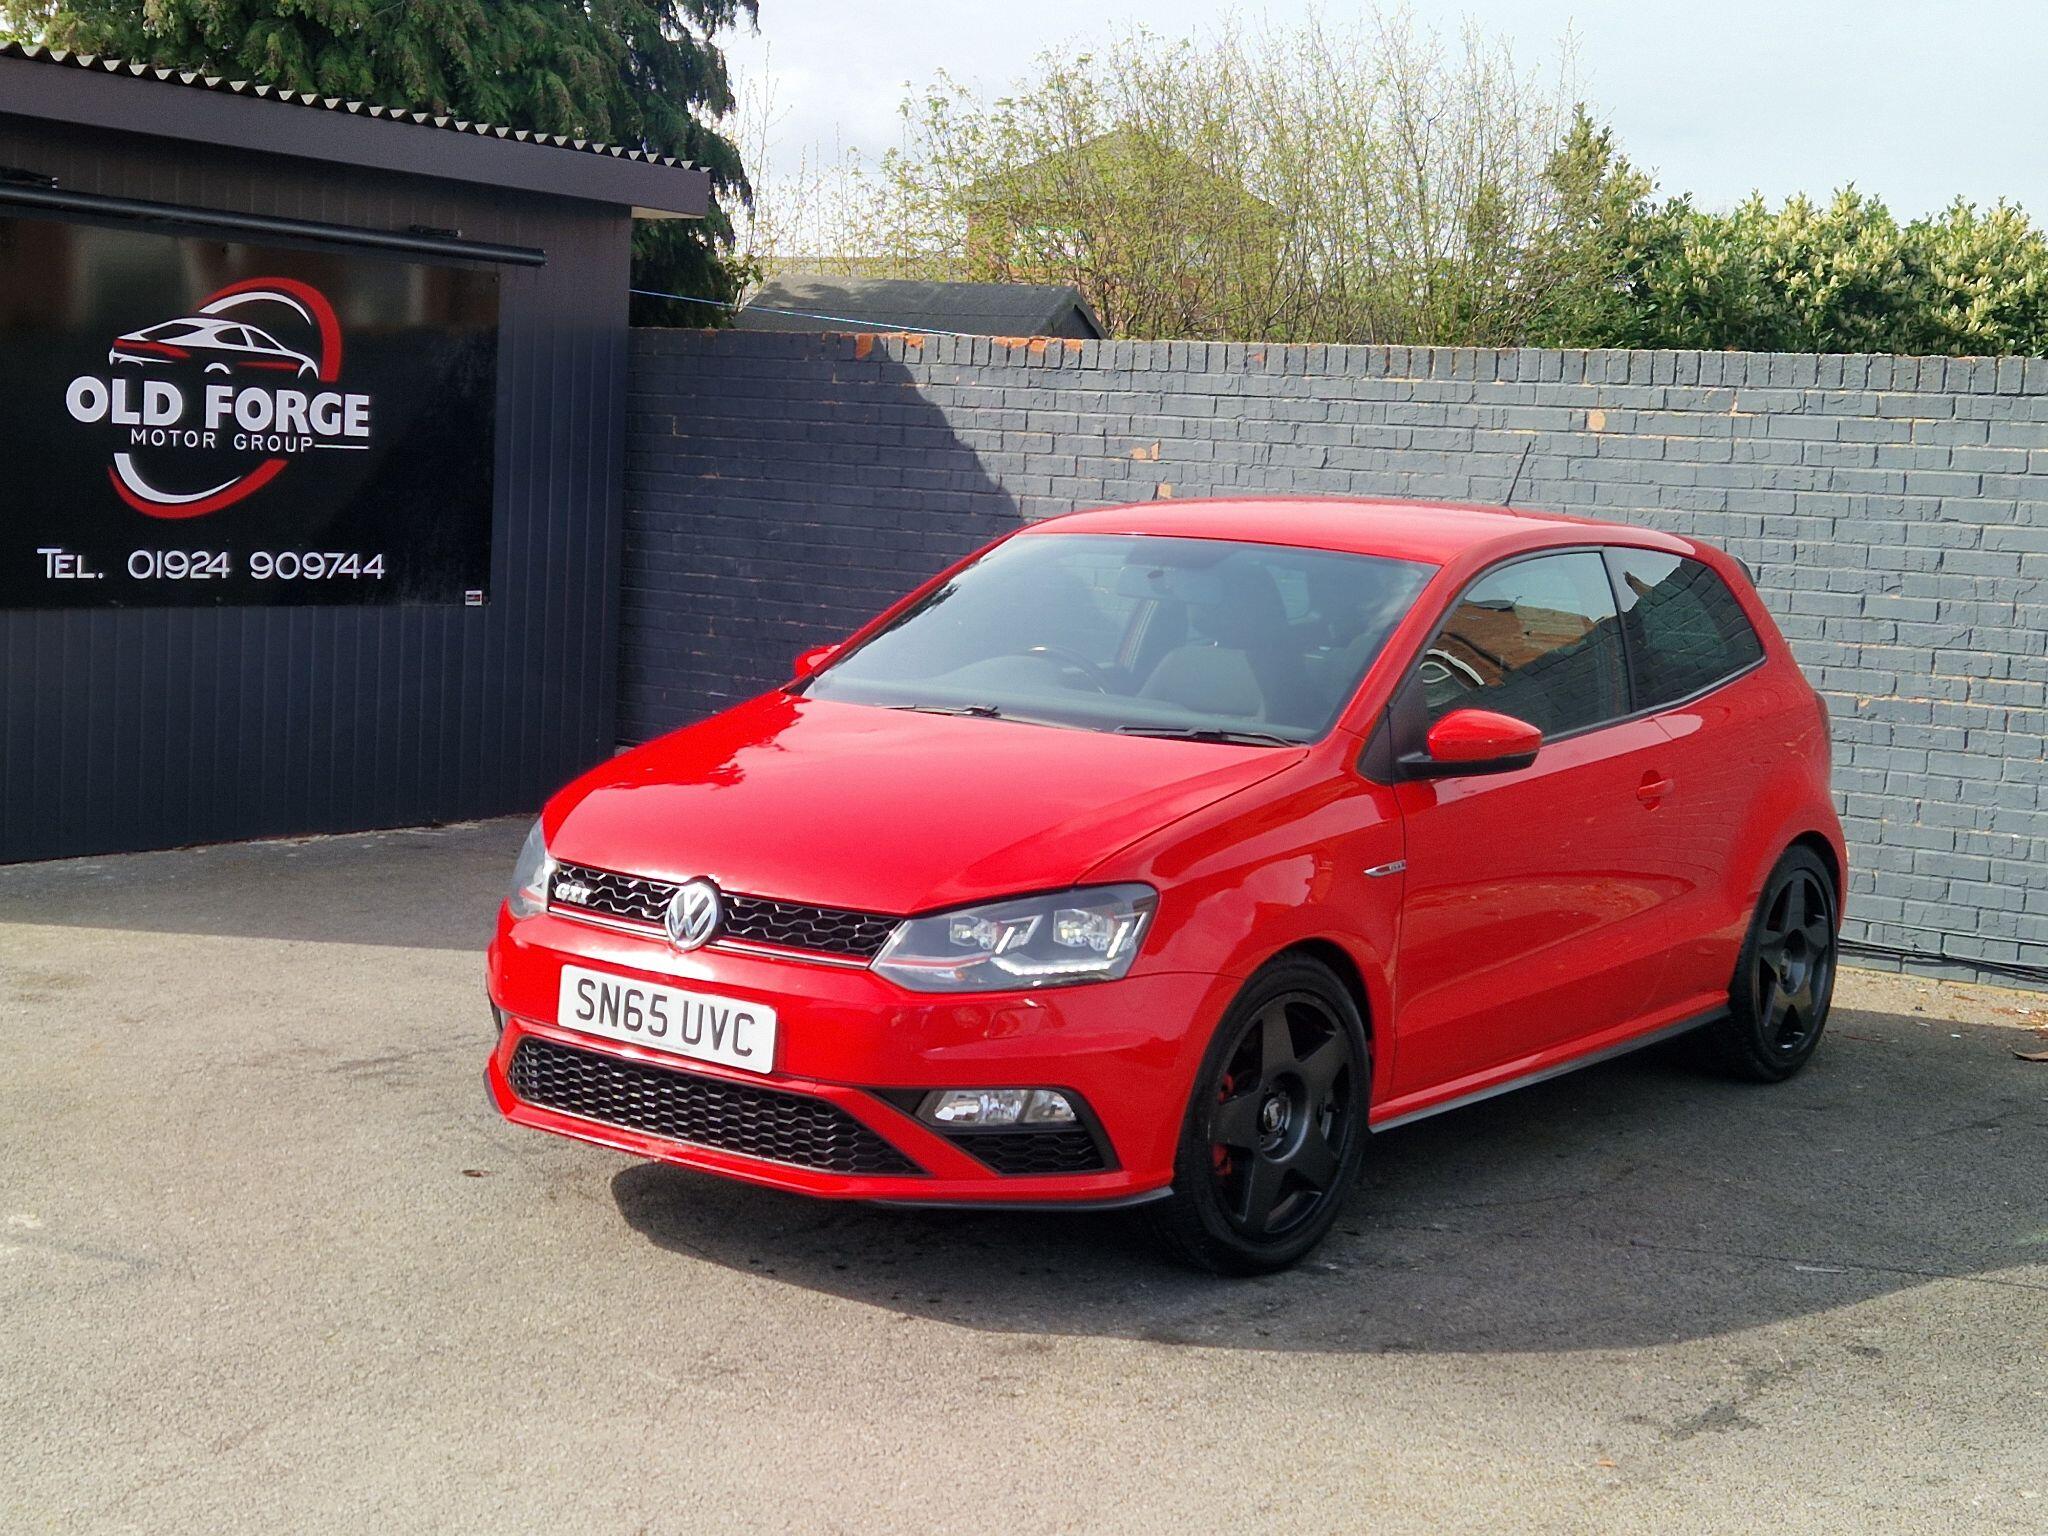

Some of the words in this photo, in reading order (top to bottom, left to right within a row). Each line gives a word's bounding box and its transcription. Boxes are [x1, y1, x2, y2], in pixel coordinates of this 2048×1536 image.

[66, 376, 183, 426] OLD
[206, 385, 370, 437] FORGE
[131, 429, 216, 449] MOTOR
[234, 434, 313, 453] GROUP
[128, 551, 230, 580] 01924
[249, 552, 385, 580] 909744
[576, 978, 668, 1038] SN65
[681, 1000, 756, 1057] UVC
